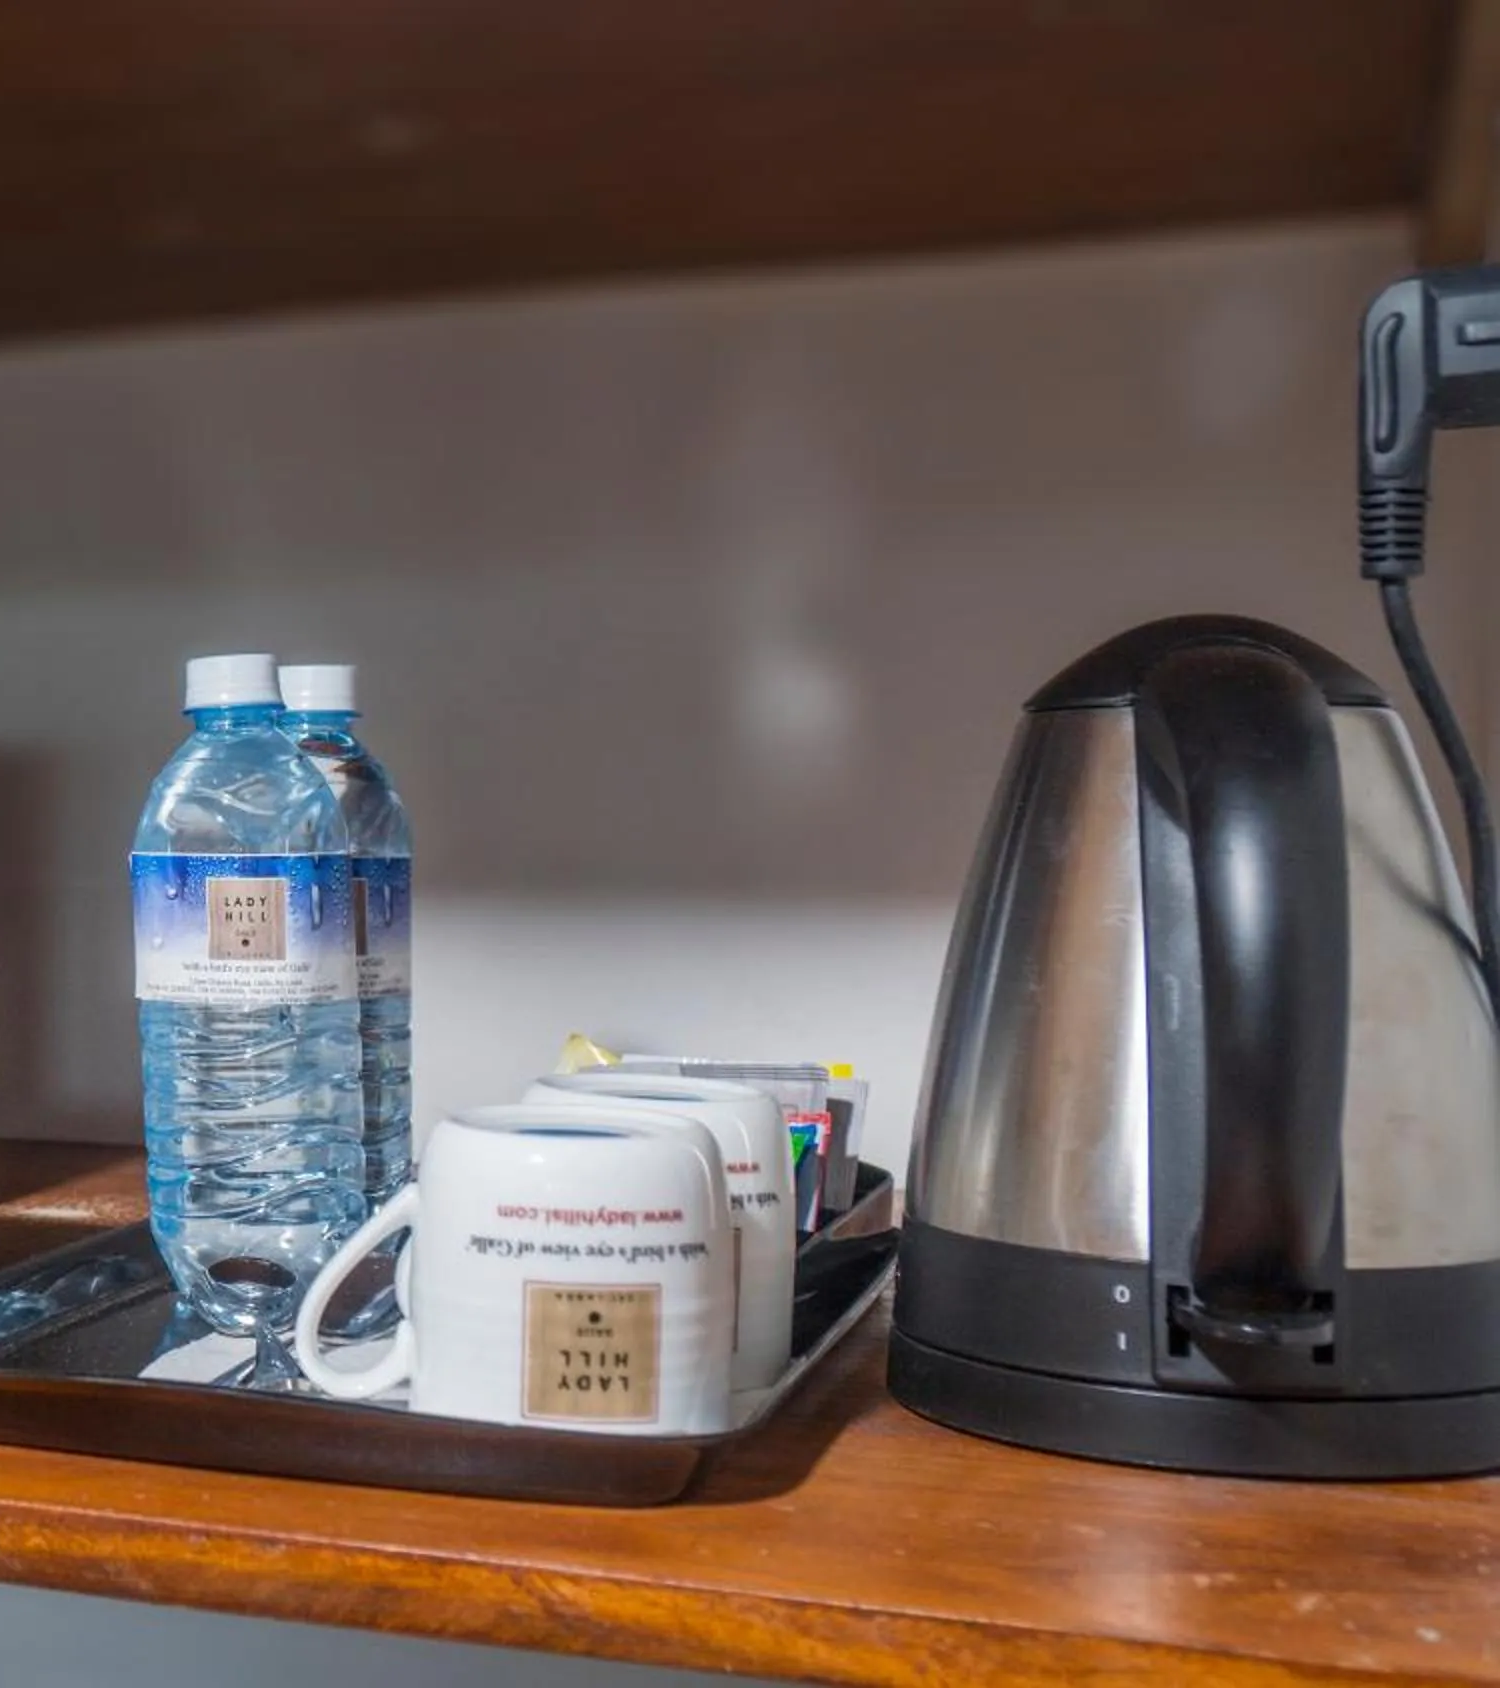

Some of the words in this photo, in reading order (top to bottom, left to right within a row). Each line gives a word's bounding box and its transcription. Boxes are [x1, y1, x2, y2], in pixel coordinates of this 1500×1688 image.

[224, 896, 267, 907] LADY
[225, 911, 266, 923] HILL
[515, 1240, 535, 1259] of
[541, 1244, 580, 1261] view
[585, 1241, 614, 1257] eye
[559, 1349, 628, 1368] HILL
[557, 1373, 628, 1392] LADY
